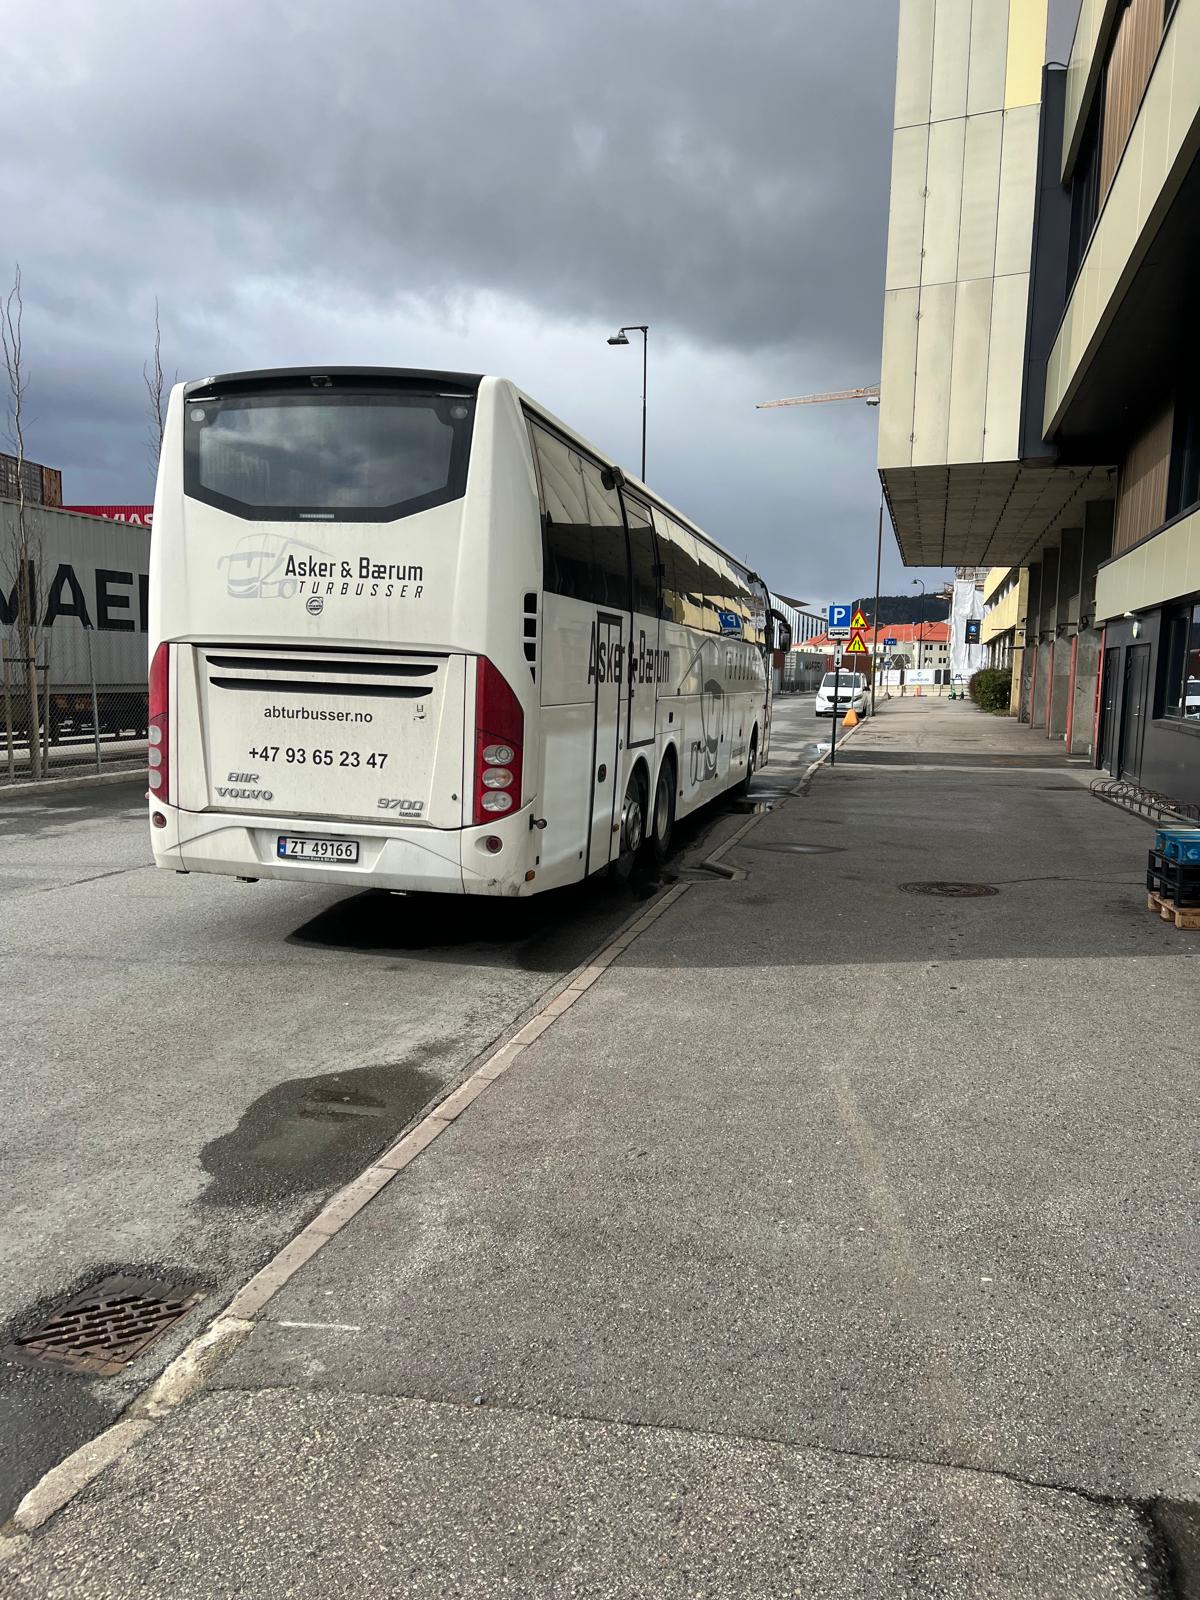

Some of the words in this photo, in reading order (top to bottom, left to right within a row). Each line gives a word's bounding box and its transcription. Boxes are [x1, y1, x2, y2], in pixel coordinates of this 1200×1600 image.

[285, 554, 336, 578] Asker
[340, 561, 353, 579] &
[358, 556, 424, 581] Bærum
[0, 559, 149, 633] MAE
[298, 581, 424, 598] TURBUSSER
[833, 607, 846, 625] P
[587, 620, 625, 685] Asker
[639, 629, 670, 684] Bærum
[263, 705, 374, 723] abturbusser.no
[248, 746, 280, 762] +47
[285, 747, 307, 764] 93
[312, 750, 334, 766] 65
[339, 751, 361, 767] 23
[366, 753, 389, 769] 47
[214, 786, 273, 801] VOLVO
[377, 798, 424, 811] 9700
[290, 840, 307, 855] ZT
[311, 842, 353, 857] 49166
